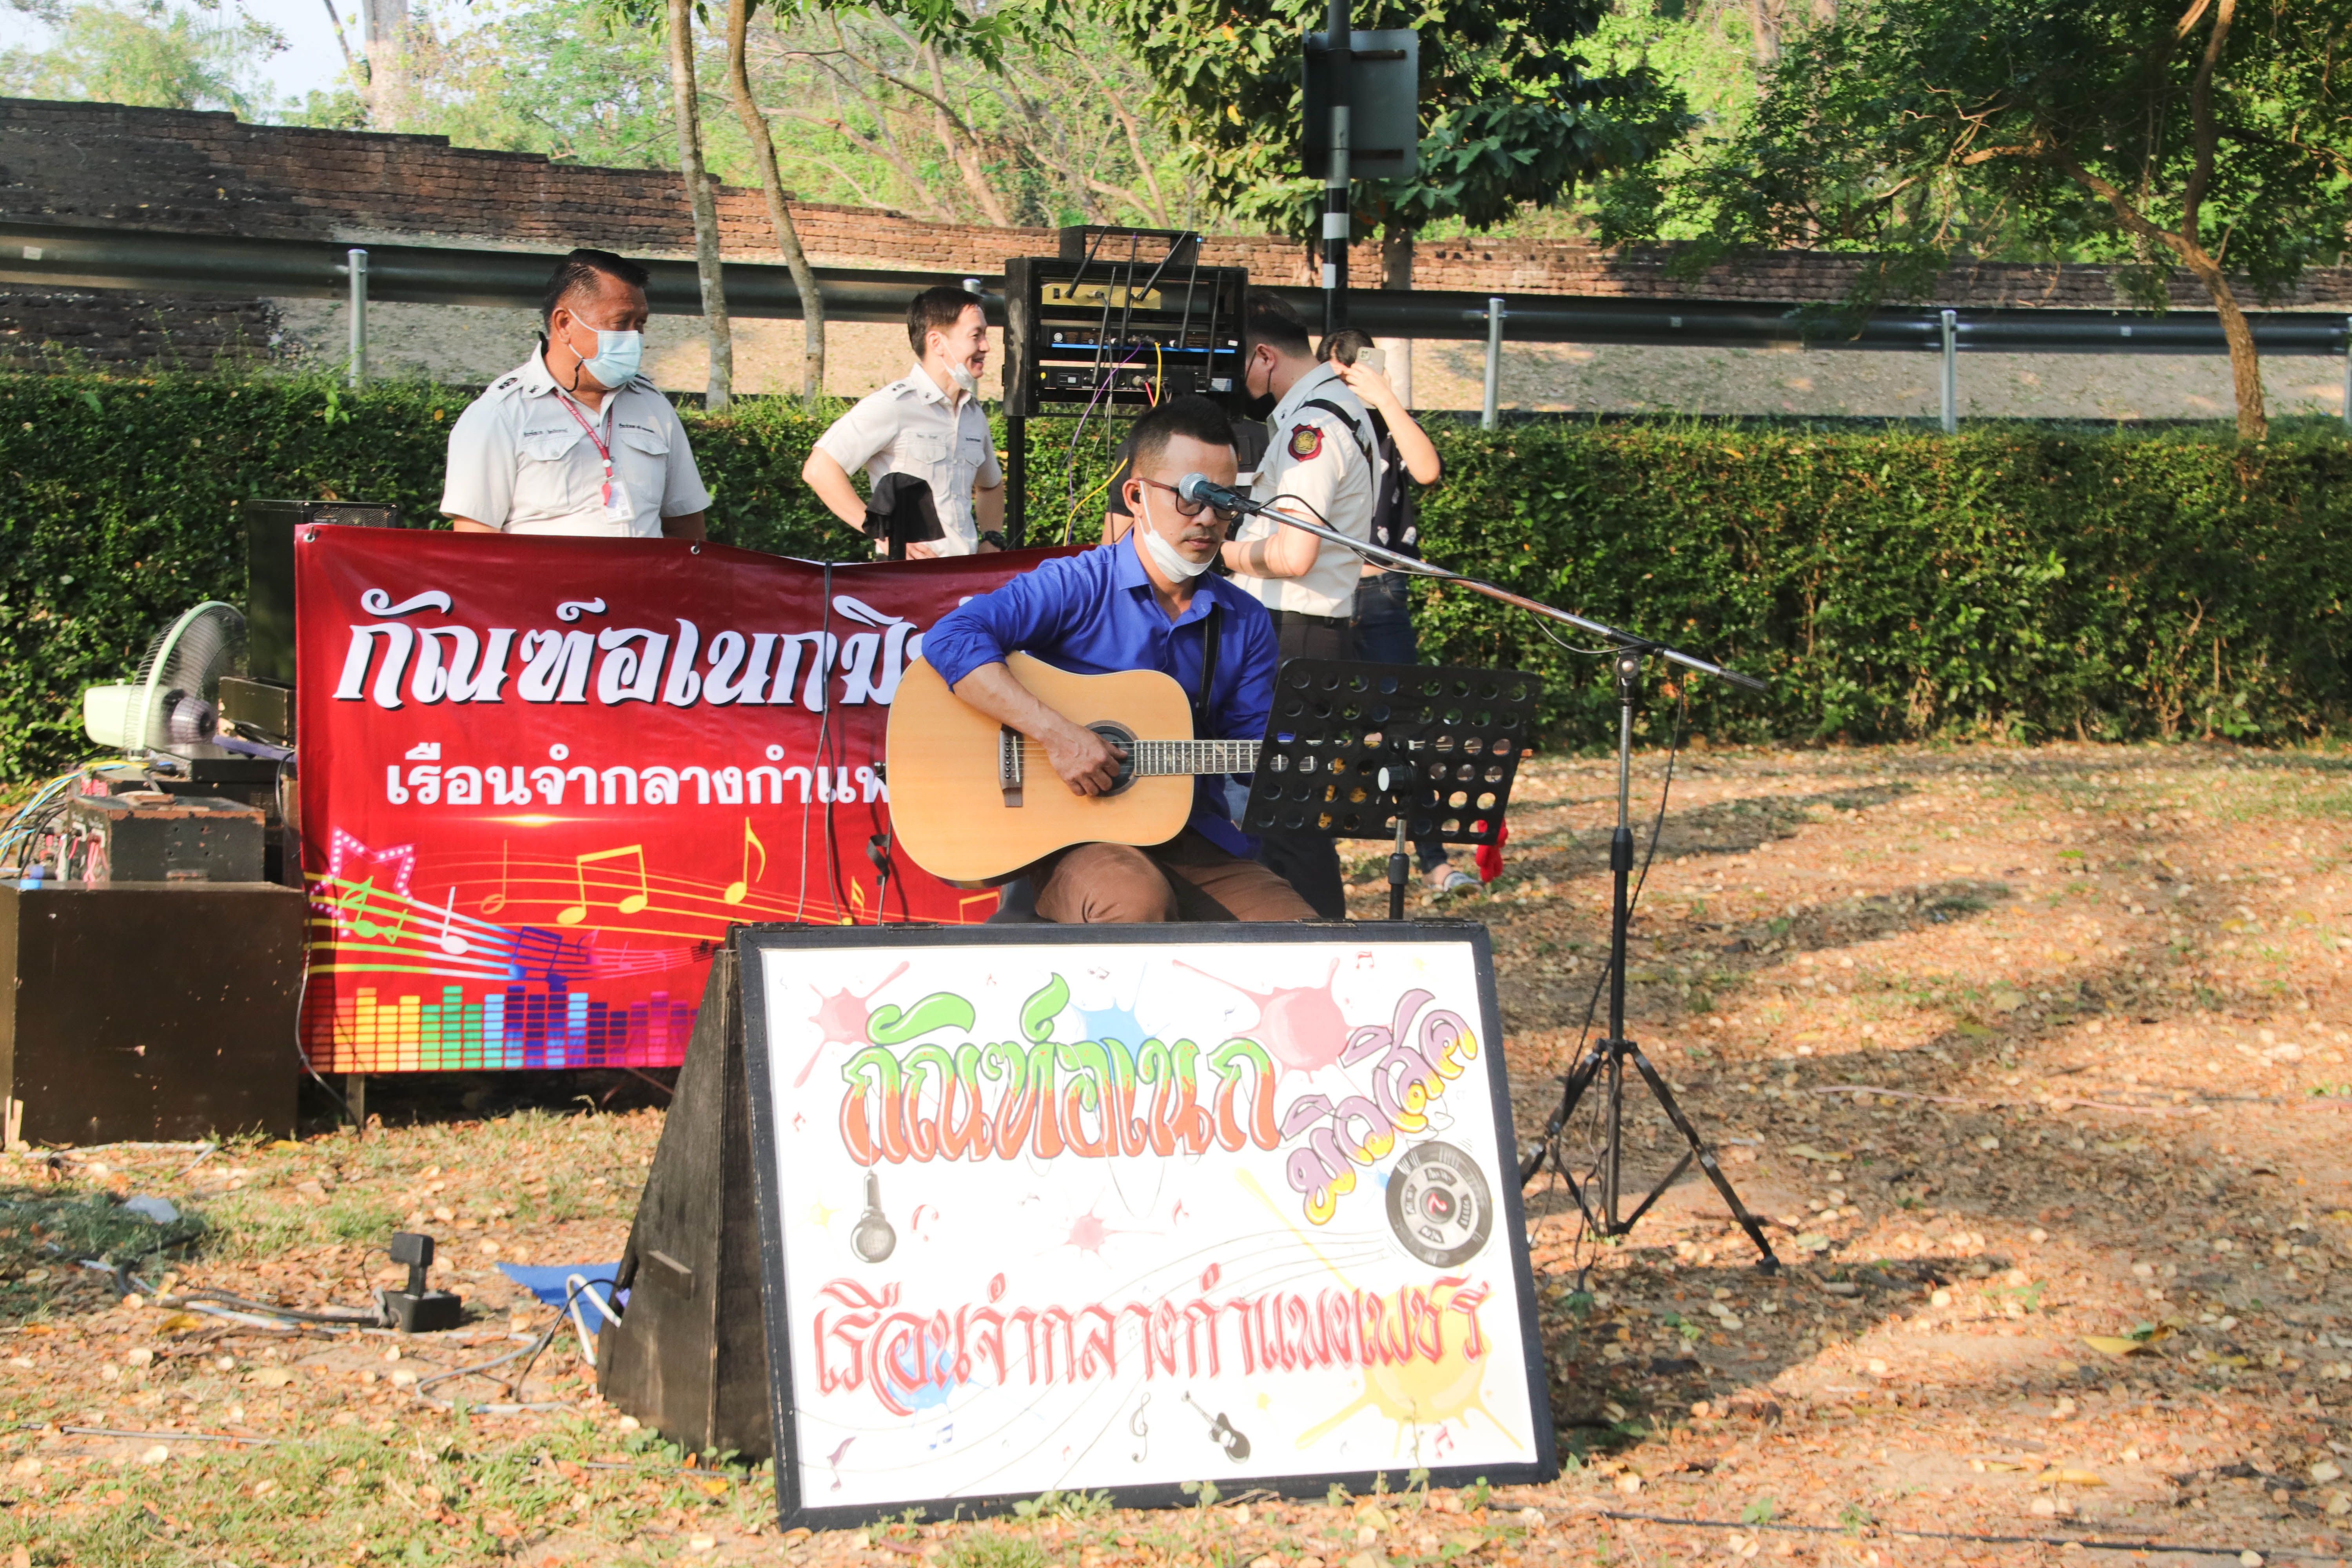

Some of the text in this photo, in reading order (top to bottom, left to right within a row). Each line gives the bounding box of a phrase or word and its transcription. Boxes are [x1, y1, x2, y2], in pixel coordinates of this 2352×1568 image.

[332, 588, 924, 712] กัณฑ์อเนกมิ
[813, 1262, 1490, 1417] เรือนจำกลางกำแพงเพชร
